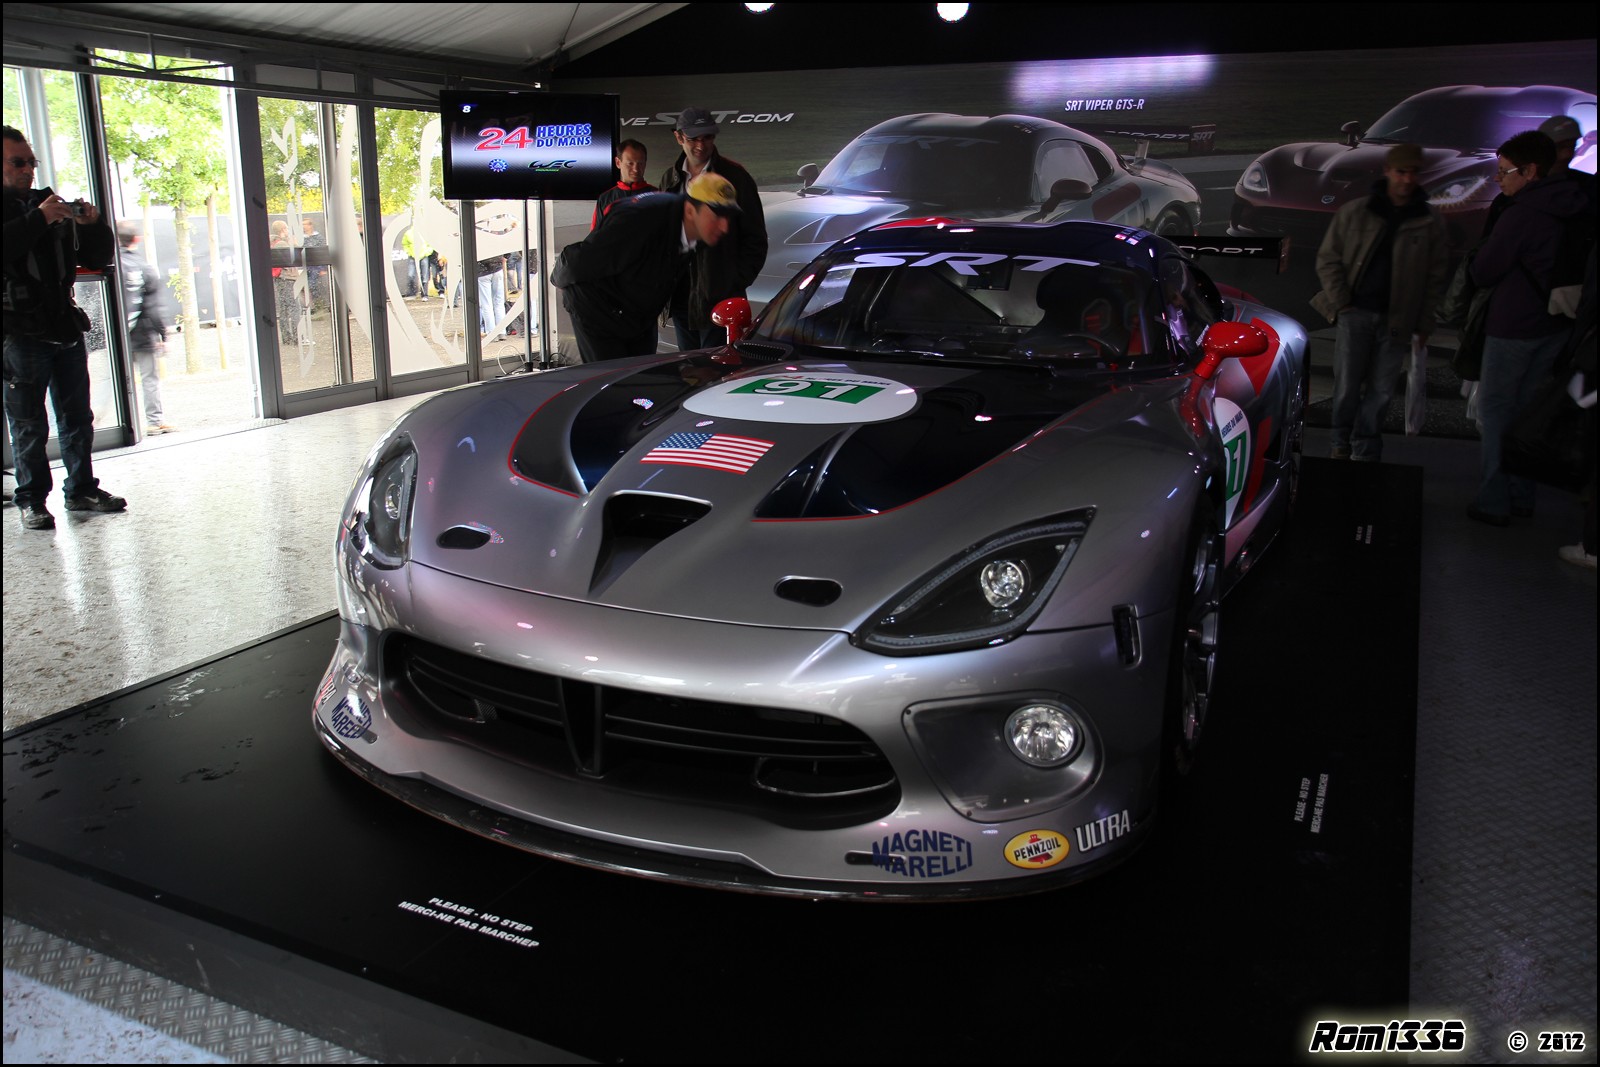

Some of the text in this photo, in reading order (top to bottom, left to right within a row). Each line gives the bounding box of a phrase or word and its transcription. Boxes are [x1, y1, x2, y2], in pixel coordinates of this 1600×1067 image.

[462, 105, 472, 113] 8
[1065, 98, 1145, 111] SRT VIPER GTS-R
[474, 123, 592, 151] 24 HEURES
[536, 136, 591, 148] DU MANS
[827, 251, 1100, 276] SRT
[753, 380, 860, 400] 91
[1299, 790, 1309, 800] NO
[1301, 778, 1310, 790] STEP
[1294, 801, 1306, 821] PLEASE
[1315, 796, 1325, 808] PAS
[1074, 809, 1131, 853] ULTRA
[872, 829, 972, 858] MAGNETI
[1013, 836, 1062, 861] PENNZOIL
[872, 850, 972, 878] MARELLI
[398, 901, 455, 921] MERCI-NE
[454, 918, 480, 930] PAS
[428, 897, 475, 916] PLEASE
[480, 912, 501, 923] NO
[500, 918, 534, 933] STEP
